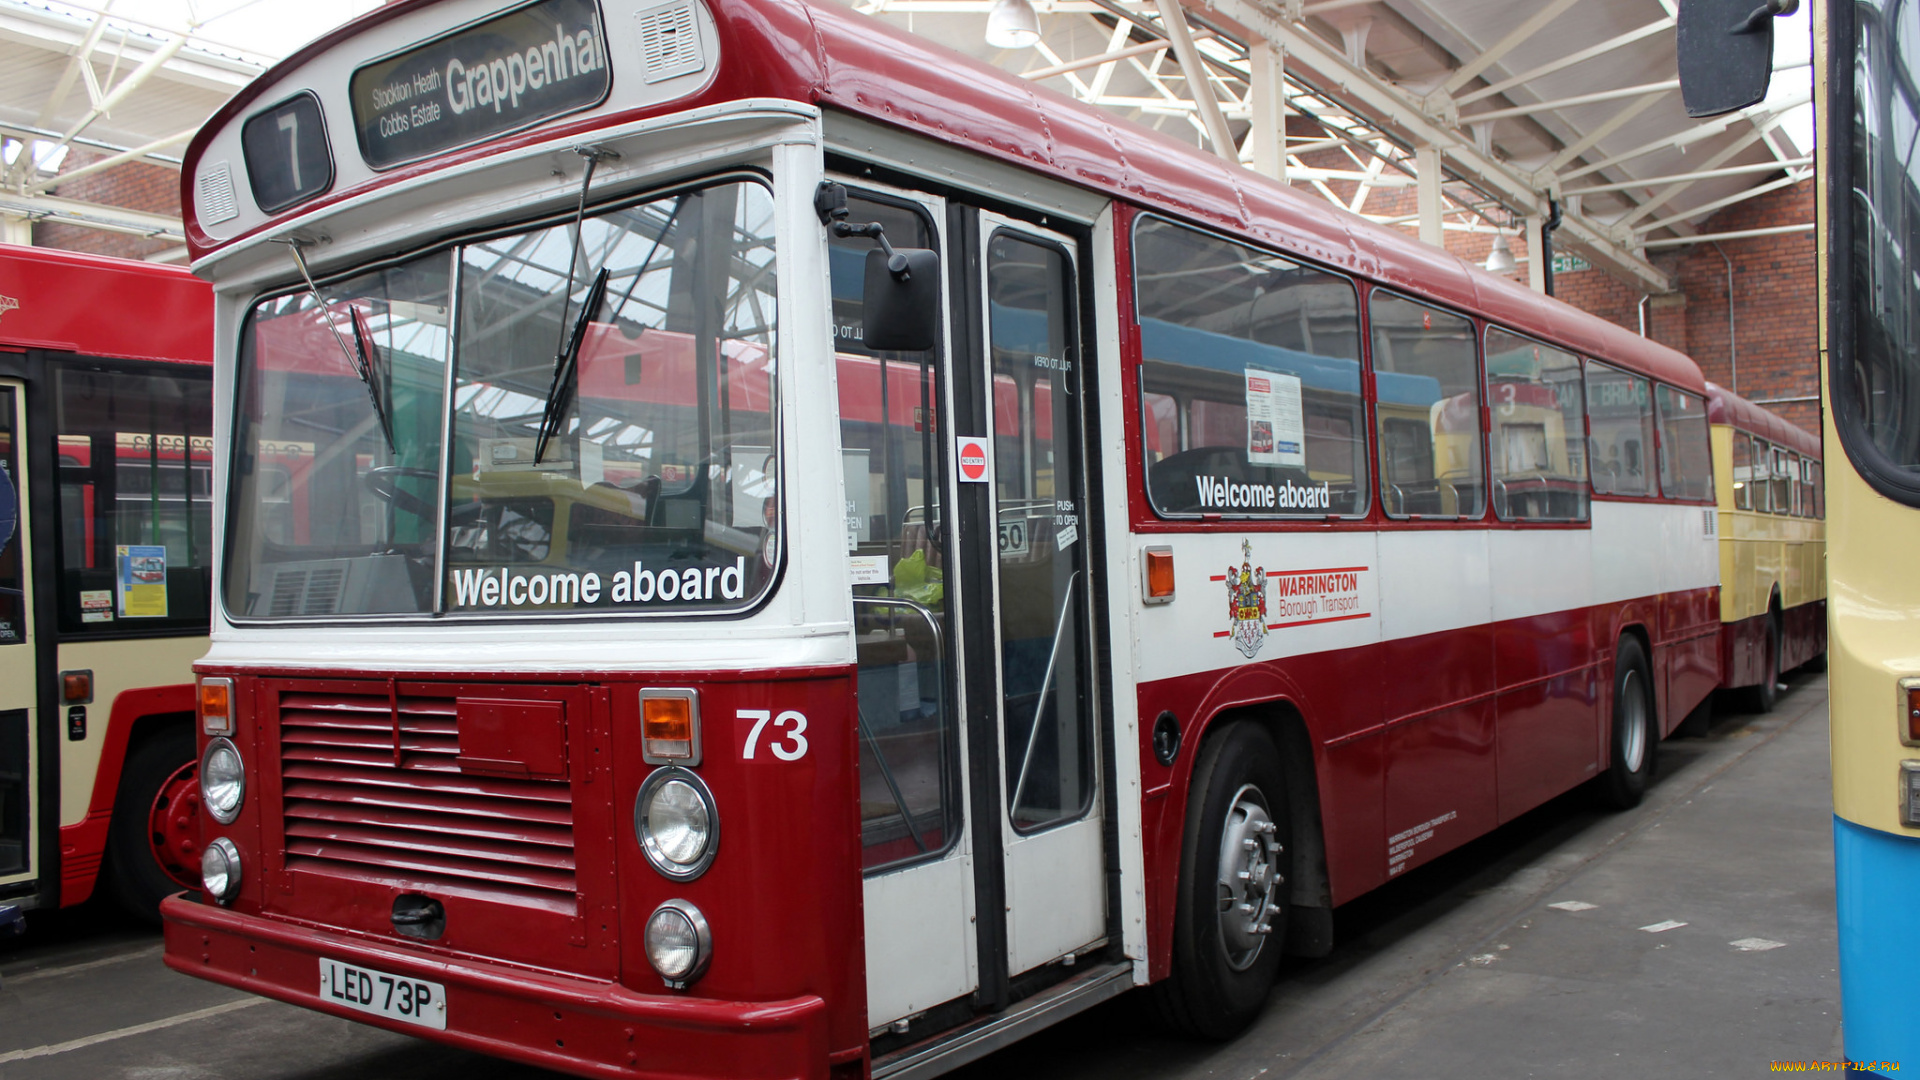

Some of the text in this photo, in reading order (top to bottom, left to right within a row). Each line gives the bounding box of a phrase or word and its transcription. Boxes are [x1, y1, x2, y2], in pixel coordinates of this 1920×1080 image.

[372, 68, 441, 110] Stockton Heath
[380, 103, 441, 138] Cobbs Estate
[277, 113, 302, 192] 7
[1057, 501, 1075, 511] PUSH
[1196, 475, 1330, 509] Welcome aboard
[1056, 514, 1079, 526] TO OPEN
[453, 556, 746, 607] Welcome aboard
[1279, 573, 1358, 597] WARRINGTON
[1279, 593, 1360, 619] Borough Transport
[736, 710, 809, 761] 73
[329, 964, 432, 1019] LED 73P
